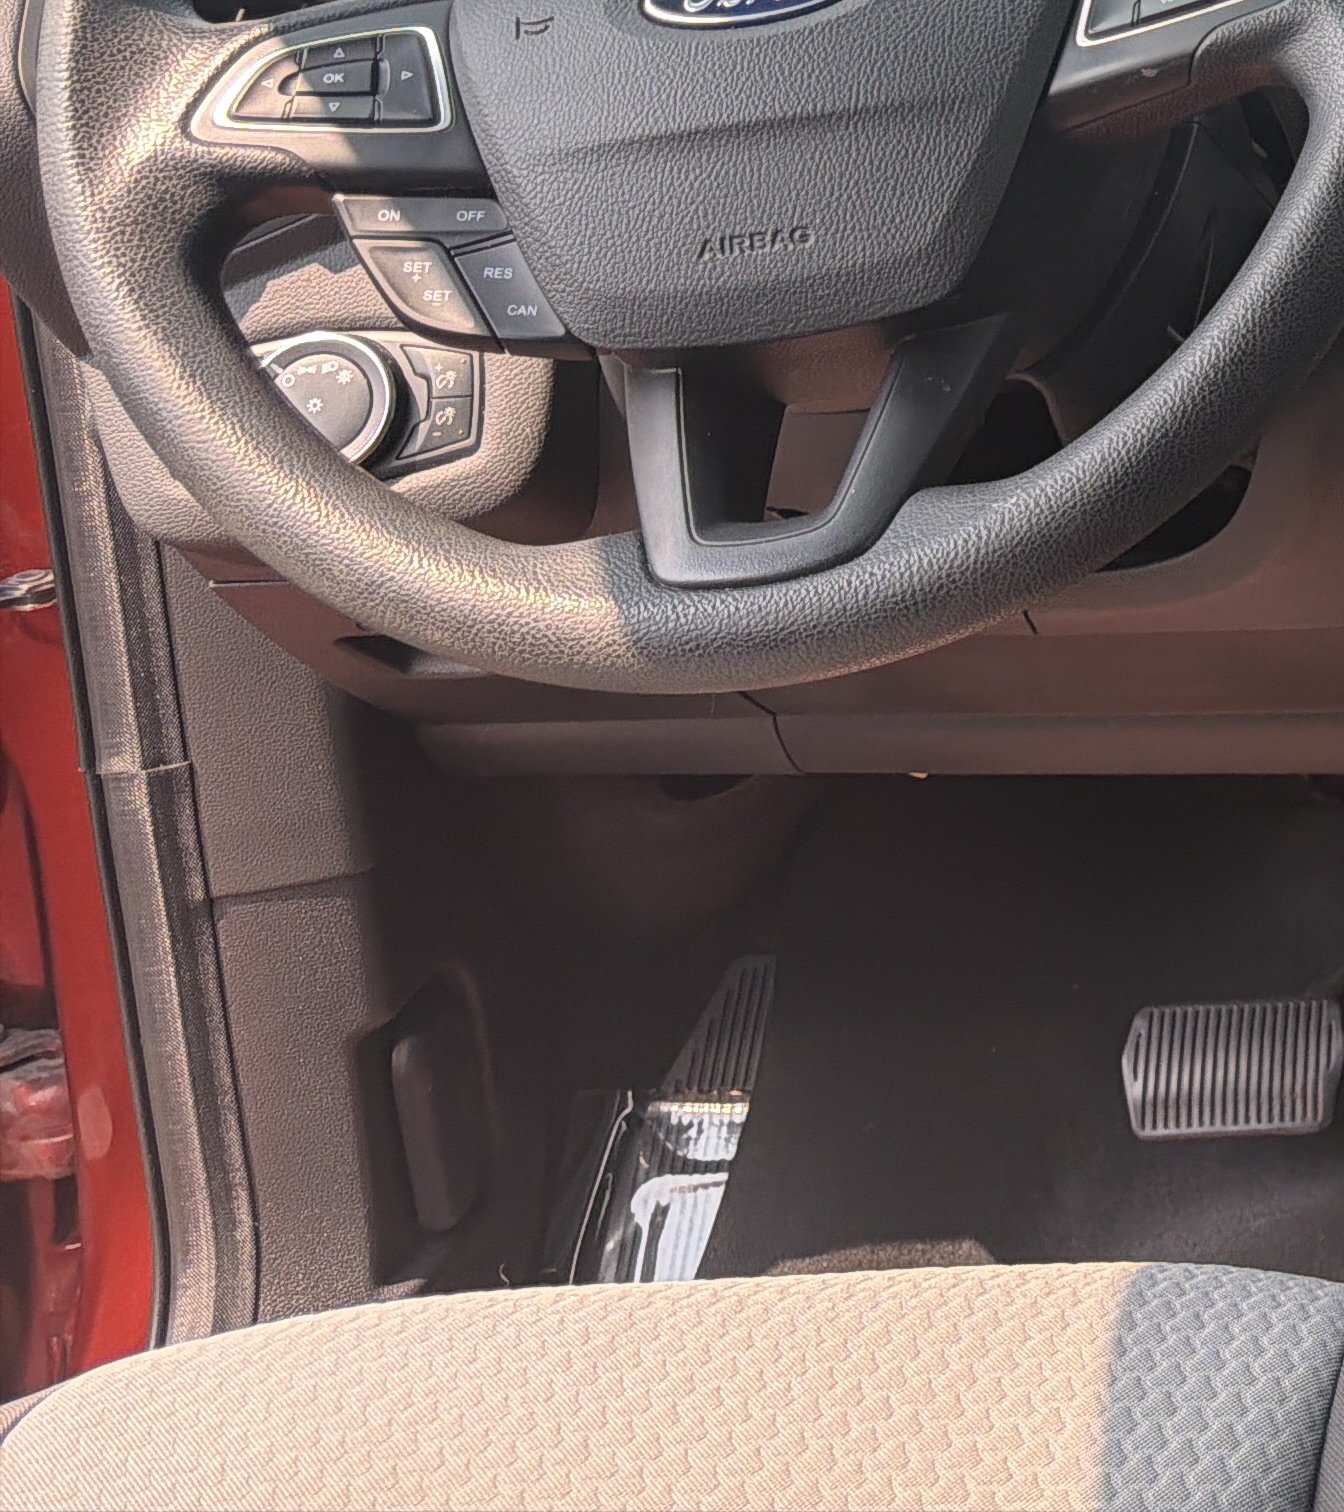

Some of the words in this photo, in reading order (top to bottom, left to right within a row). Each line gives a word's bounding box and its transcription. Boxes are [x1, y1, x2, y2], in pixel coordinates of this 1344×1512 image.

[323, 72, 345, 84] OK
[377, 209, 401, 223] ON
[456, 209, 486, 223] OFF
[697, 227, 816, 261] AIRBAG
[402, 261, 432, 275] SET
[483, 266, 514, 280] RES
[423, 289, 452, 303] SET
[507, 304, 538, 317] CAN
